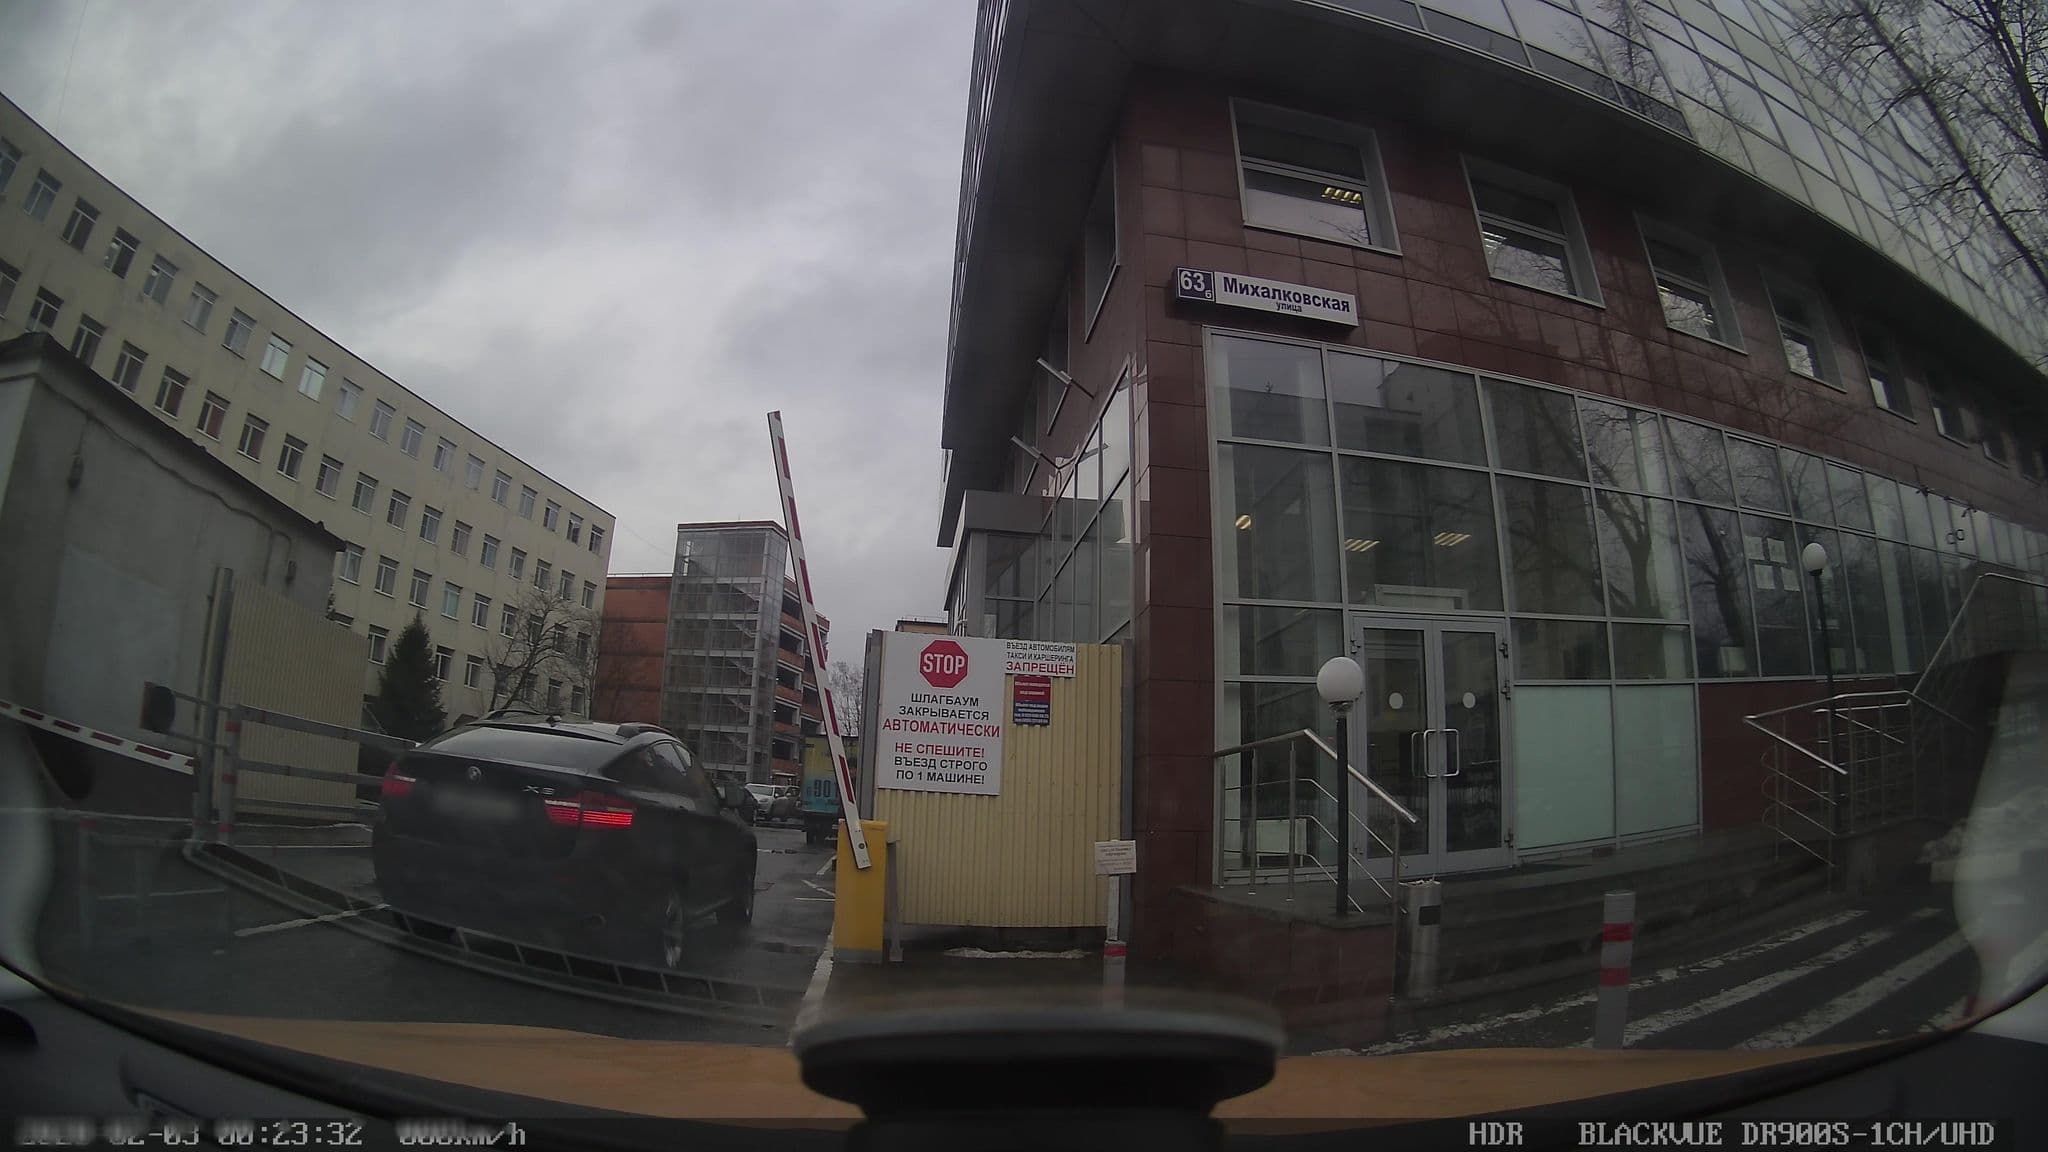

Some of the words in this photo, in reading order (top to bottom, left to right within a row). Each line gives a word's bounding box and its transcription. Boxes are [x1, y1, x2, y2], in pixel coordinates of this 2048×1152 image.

[1179, 270, 1205, 293] 63
[1223, 276, 1351, 313] Михалковская
[1275, 301, 1303, 313] улица
[1006, 641, 1028, 651] ВЪЕЗД
[1029, 643, 1075, 653] АВТОМОБИЛЯМ
[923, 652, 965, 675] STOP
[1006, 651, 1027, 660] ТАКСИ
[1027, 652, 1033, 660] И
[1033, 652, 1074, 663] КАРШЕРИНГА
[911, 693, 979, 707] ШЛАГБАУМ
[899, 706, 989, 721] ЗАКРЫВАЕТСЯ
[882, 718, 1000, 738] АВТОМАТИЧЕСКИ
[895, 742, 913, 753] НЕ
[916, 743, 985, 758] СПЕШИТЕ!
[894, 756, 937, 769] ВЪЕЗД
[940, 759, 988, 771] СТРОГО
[896, 769, 914, 780] ПО
[917, 771, 923, 781] 1
[926, 772, 985, 785] МАШИНЕ!
